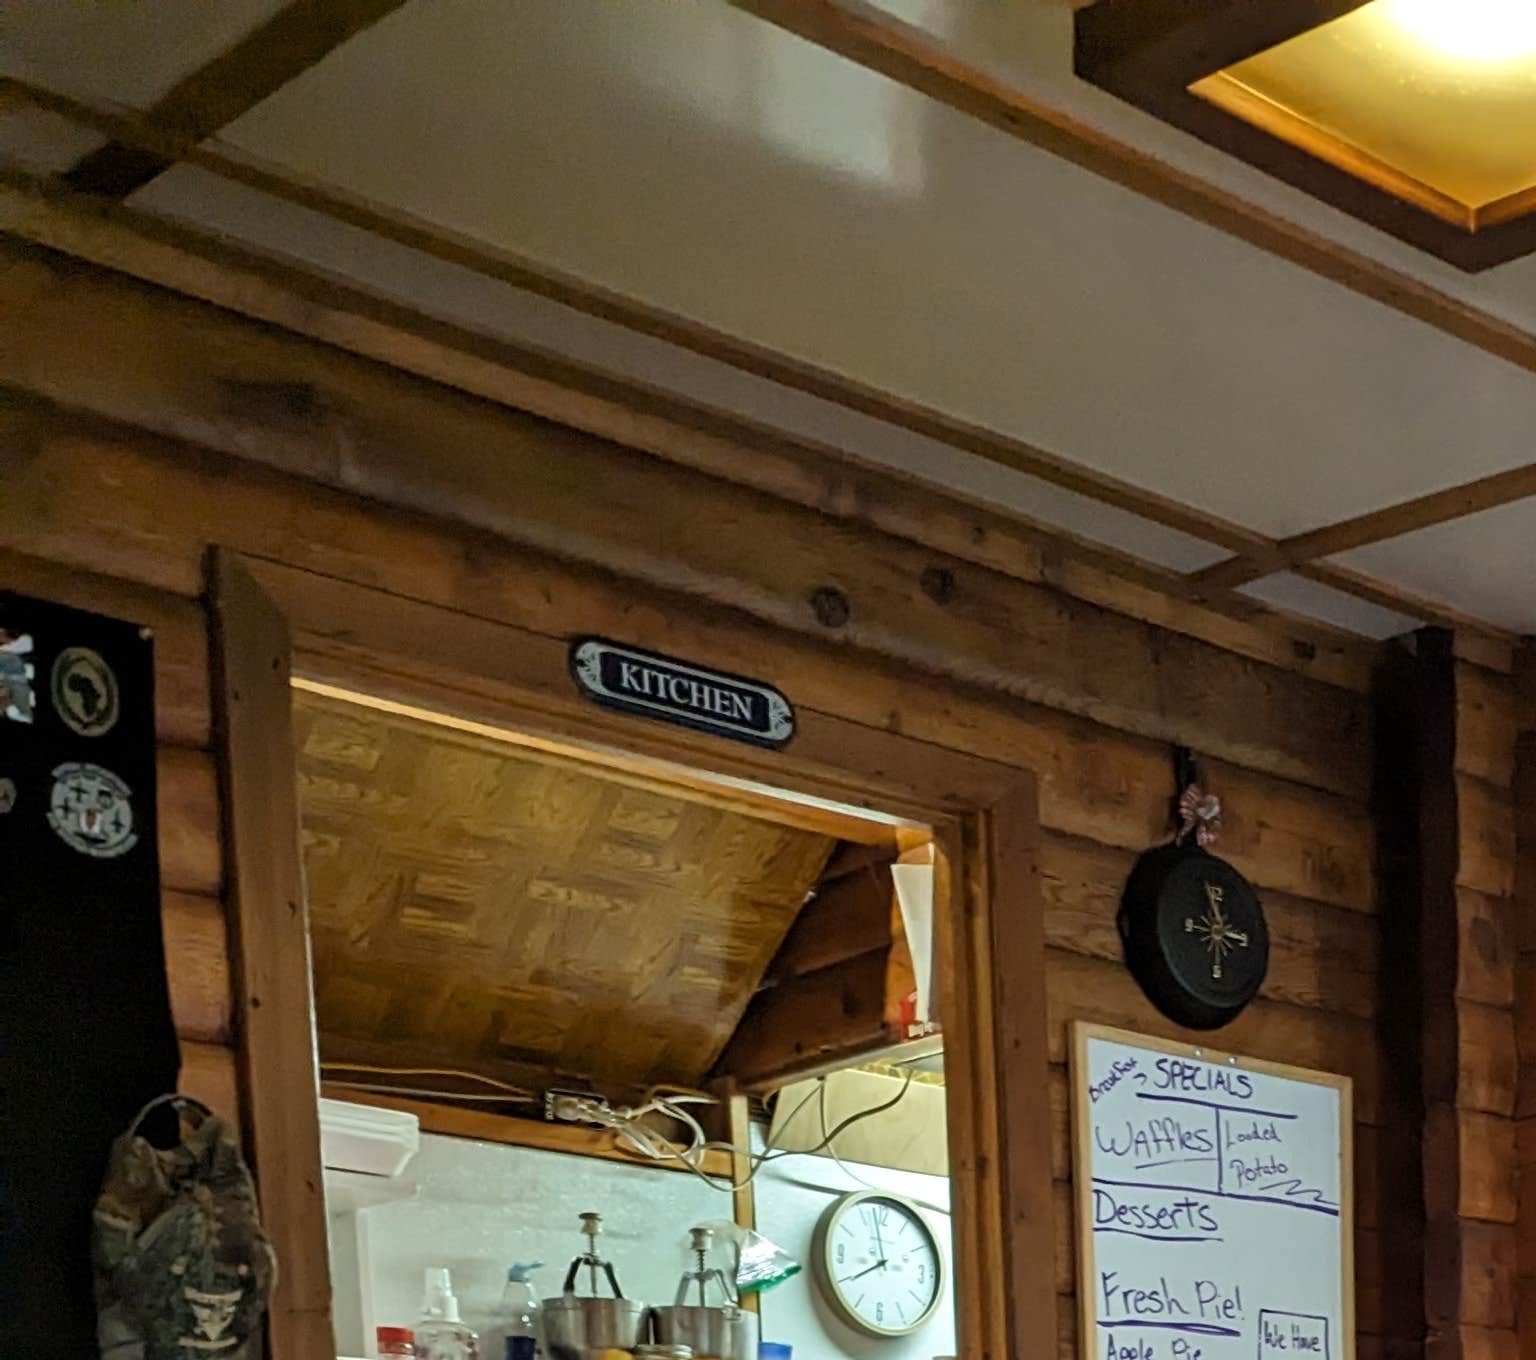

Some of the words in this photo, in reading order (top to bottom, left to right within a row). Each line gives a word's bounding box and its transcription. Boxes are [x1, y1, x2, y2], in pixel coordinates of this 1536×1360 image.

[620, 662, 752, 721] KITCHEN
[1153, 1058, 1253, 1098] SPECIALS
[1225, 1119, 1282, 1149] Loaded
[1229, 1156, 1289, 1188] Potato
[1094, 1188, 1219, 1232] Desserts
[1101, 1271, 1190, 1317] Fresh
[1194, 1280, 1245, 1321] Pie!
[1264, 1320, 1287, 1349] We
[1291, 1323, 1321, 1353] Have
